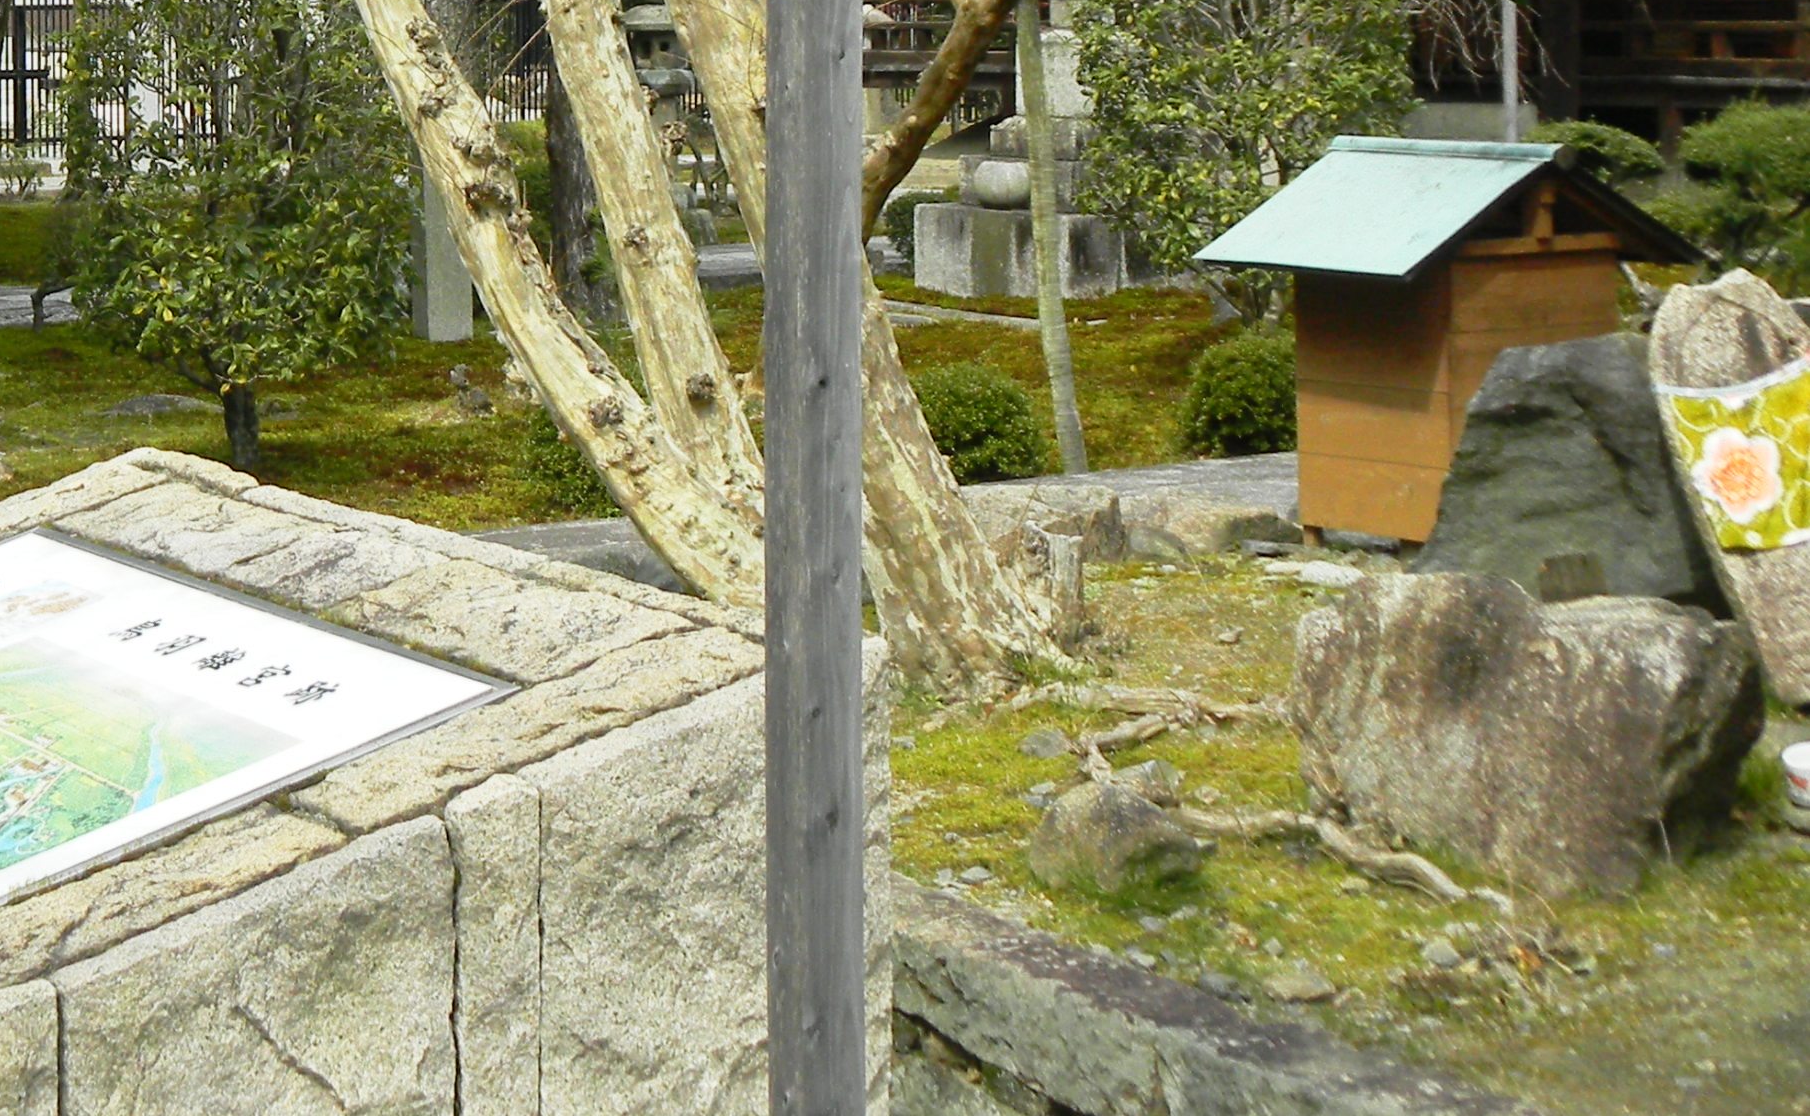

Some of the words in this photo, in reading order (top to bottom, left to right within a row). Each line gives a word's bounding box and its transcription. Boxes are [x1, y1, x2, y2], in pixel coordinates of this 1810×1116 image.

[108, 618, 340, 706] 鳥羽離宮跡
